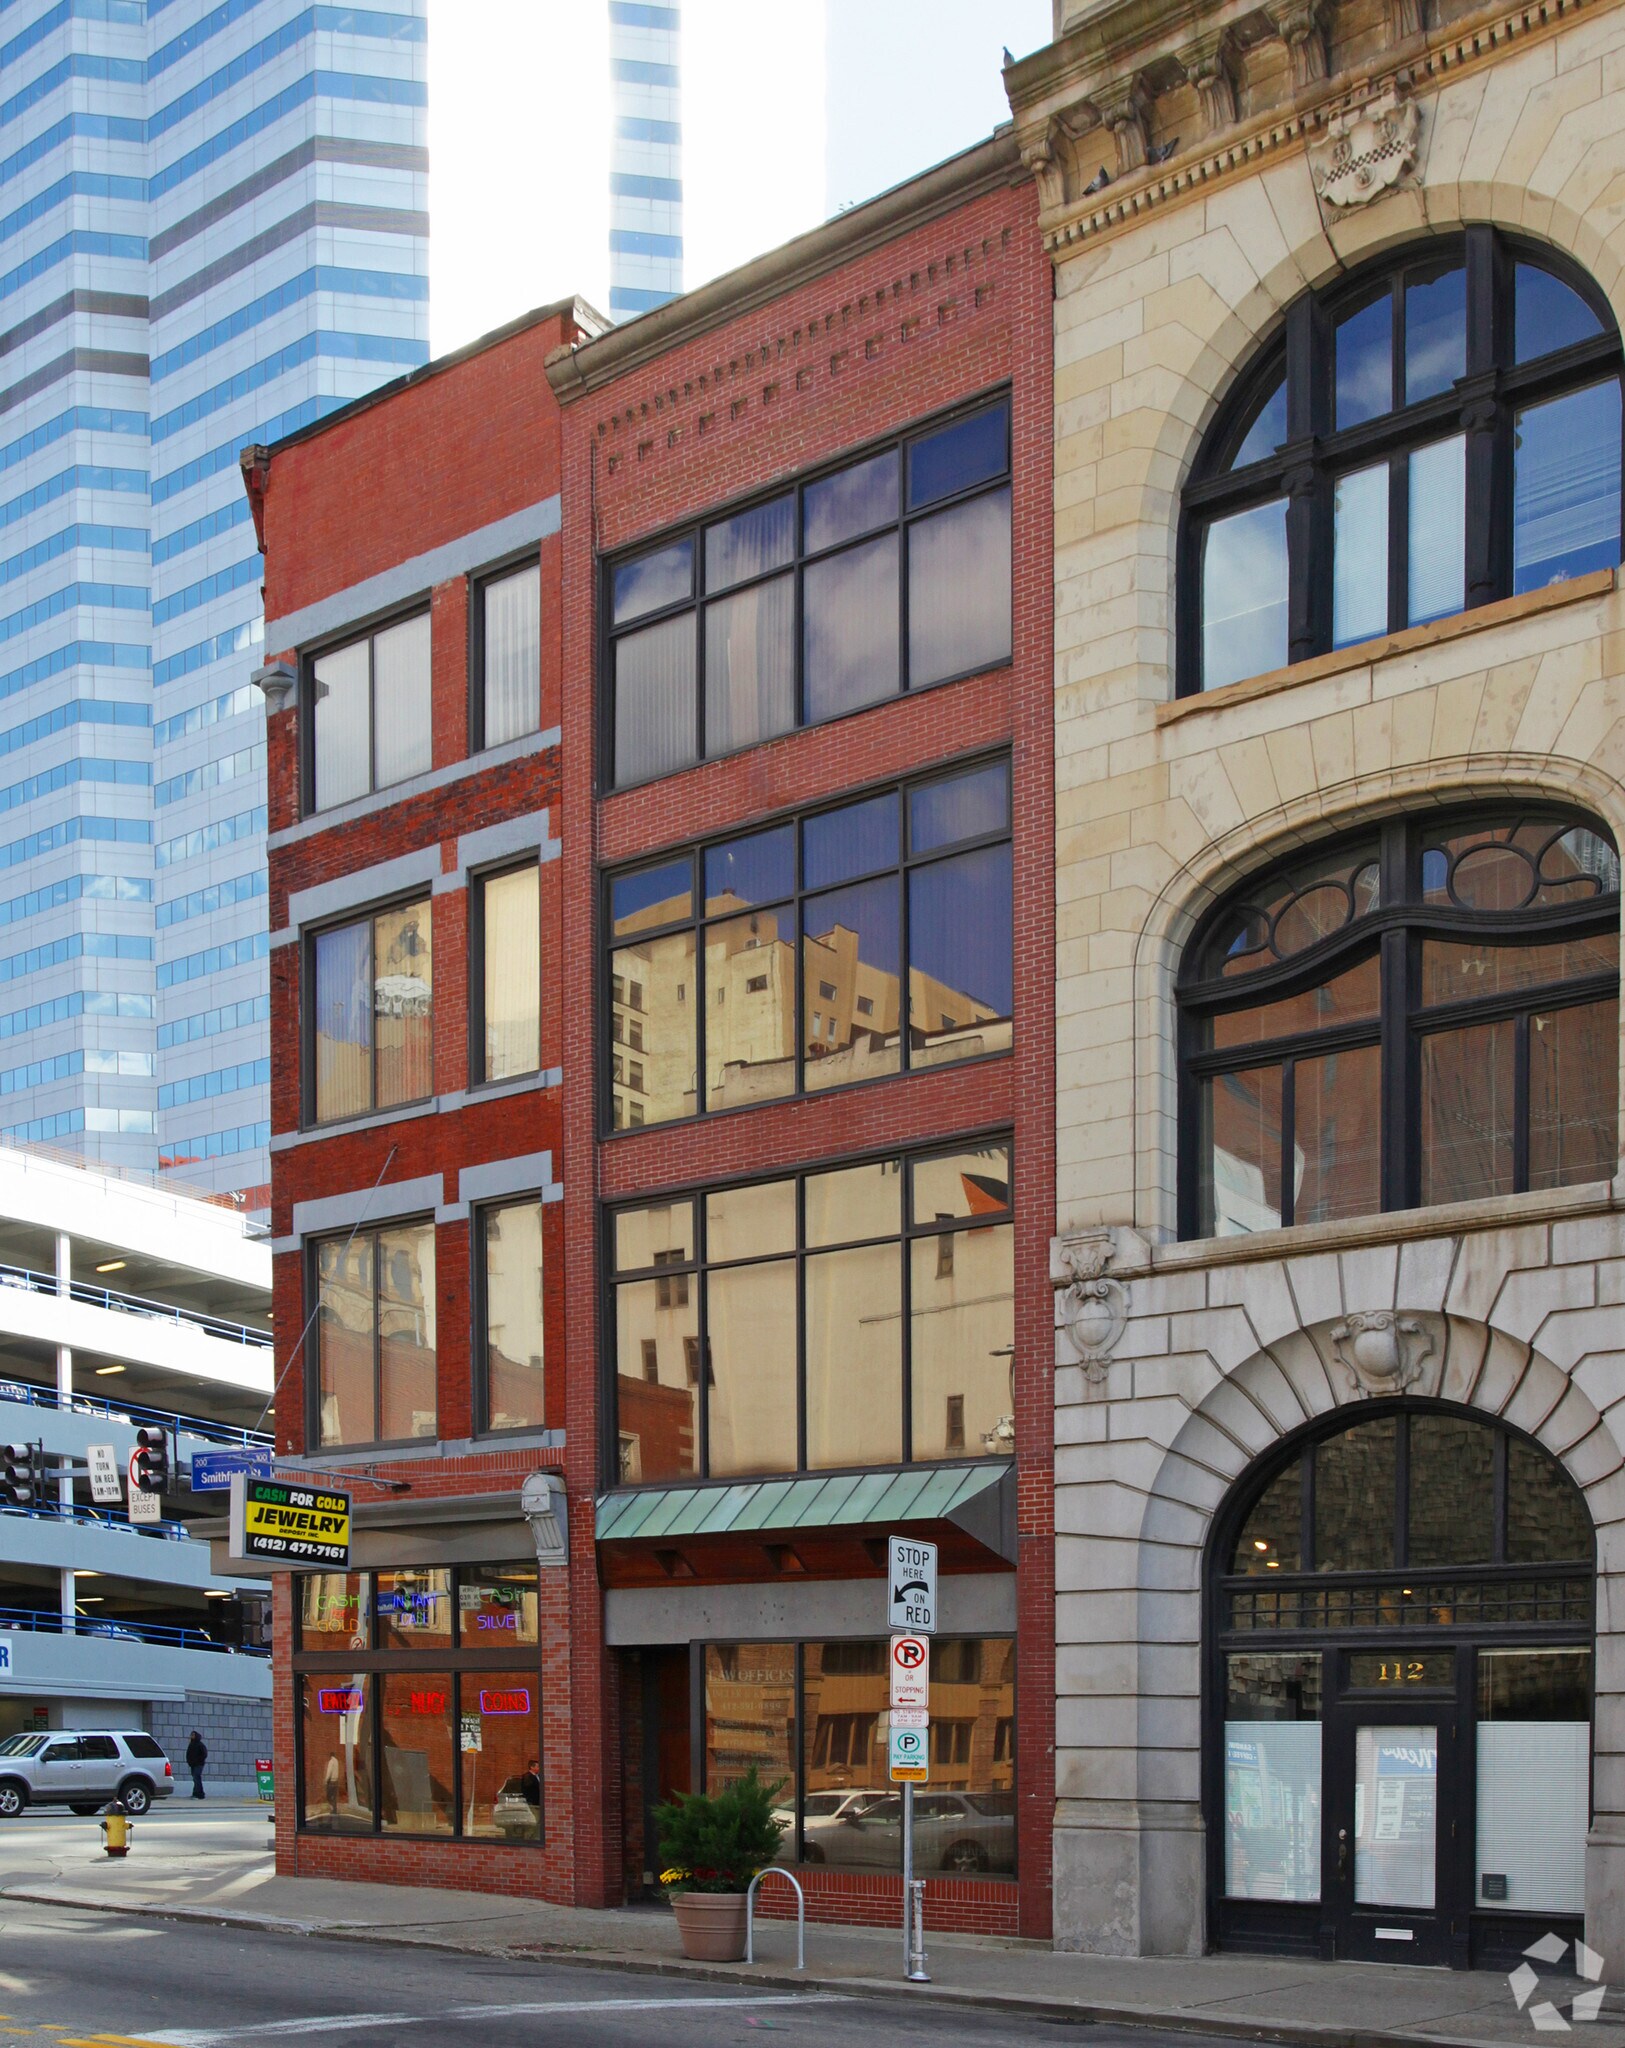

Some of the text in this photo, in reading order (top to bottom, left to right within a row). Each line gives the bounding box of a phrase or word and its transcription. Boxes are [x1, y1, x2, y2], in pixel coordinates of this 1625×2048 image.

[97, 1449, 105, 1458] NO
[95, 1462, 110, 1471] TURN
[195, 1458, 208, 1468] 200
[94, 1473, 115, 1484] ON RED
[201, 1469, 247, 1484] Smithf
[289, 1491, 315, 1507] FOR
[316, 1495, 346, 1512] GOLD
[133, 1504, 156, 1514] BUSES
[253, 1507, 346, 1534] JEWELRY
[279, 1528, 307, 1536] DEPOSIT
[253, 1536, 346, 1559] (412) 471-7161
[897, 1546, 930, 1567] STOP
[903, 1567, 924, 1580] HERE
[914, 1593, 925, 1605] ON
[906, 1605, 931, 1625] RED
[317, 1618, 361, 1633] GOLD
[709, 1669, 795, 1682] LAW OFFICES
[905, 1674, 914, 1682] OR
[1378, 1662, 1424, 1681] 112
[895, 1686, 924, 1694] STOPPING
[483, 1691, 528, 1712] COINS
[893, 1753, 925, 1761] PAY PARKING
